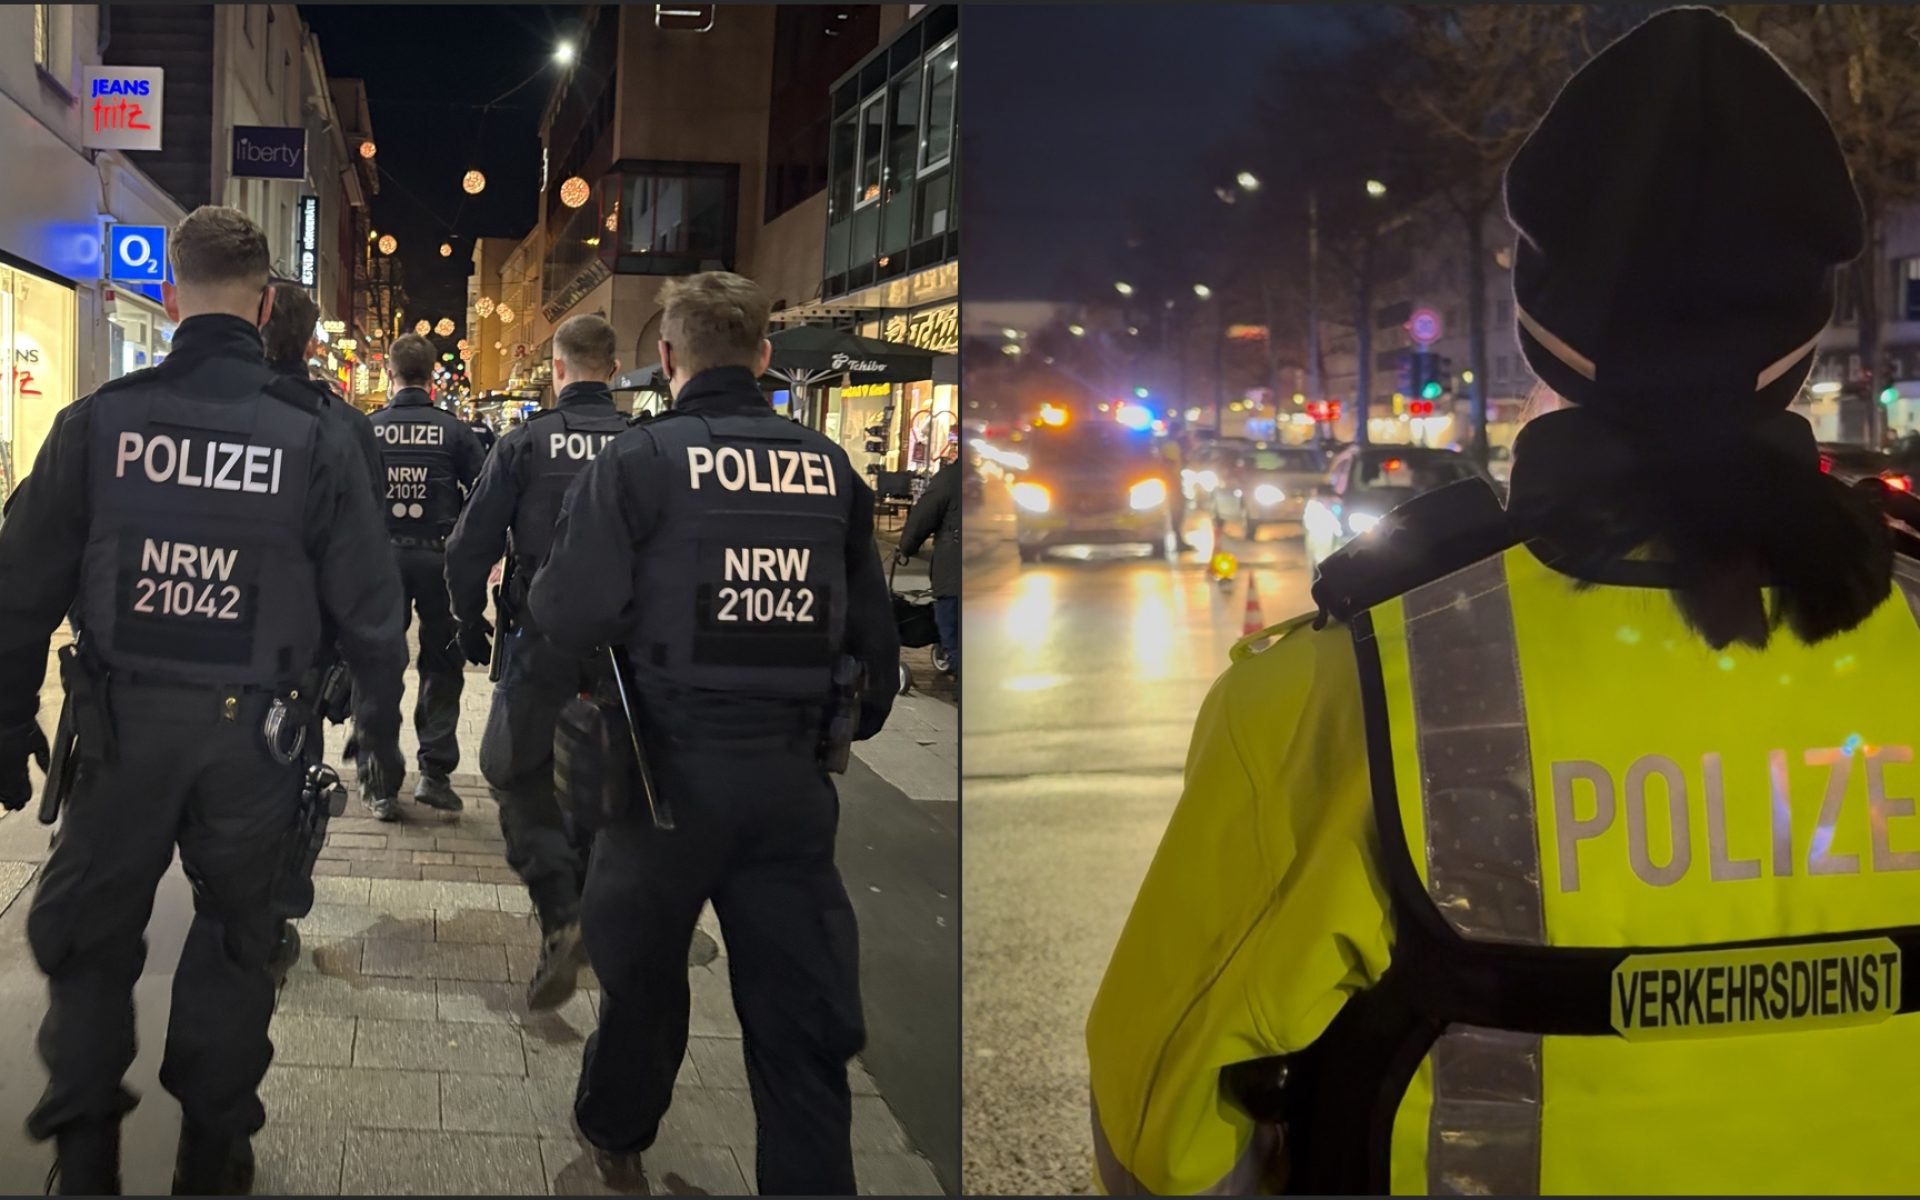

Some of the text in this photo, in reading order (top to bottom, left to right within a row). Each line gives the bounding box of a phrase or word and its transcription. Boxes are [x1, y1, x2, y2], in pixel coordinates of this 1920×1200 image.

[92, 79, 150, 98] JEANS
[91, 97, 151, 133] fritz
[236, 137, 301, 168] liberty
[119, 234, 159, 274] O2
[847, 360, 888, 372] Tchibo
[374, 425, 444, 446] POLIZEI
[550, 433, 615, 461] POLI
[115, 431, 283, 495] POLIZEI
[387, 467, 428, 482] NRW
[686, 446, 837, 497] POLIZEI
[385, 484, 428, 499] 21012
[141, 538, 239, 582] NRW
[724, 548, 811, 582] NRW
[133, 577, 241, 620] 21042
[717, 587, 815, 622] 21042
[1550, 745, 1920, 894] POLIZE
[1616, 952, 1898, 1029] VERKEHRSDIENST
